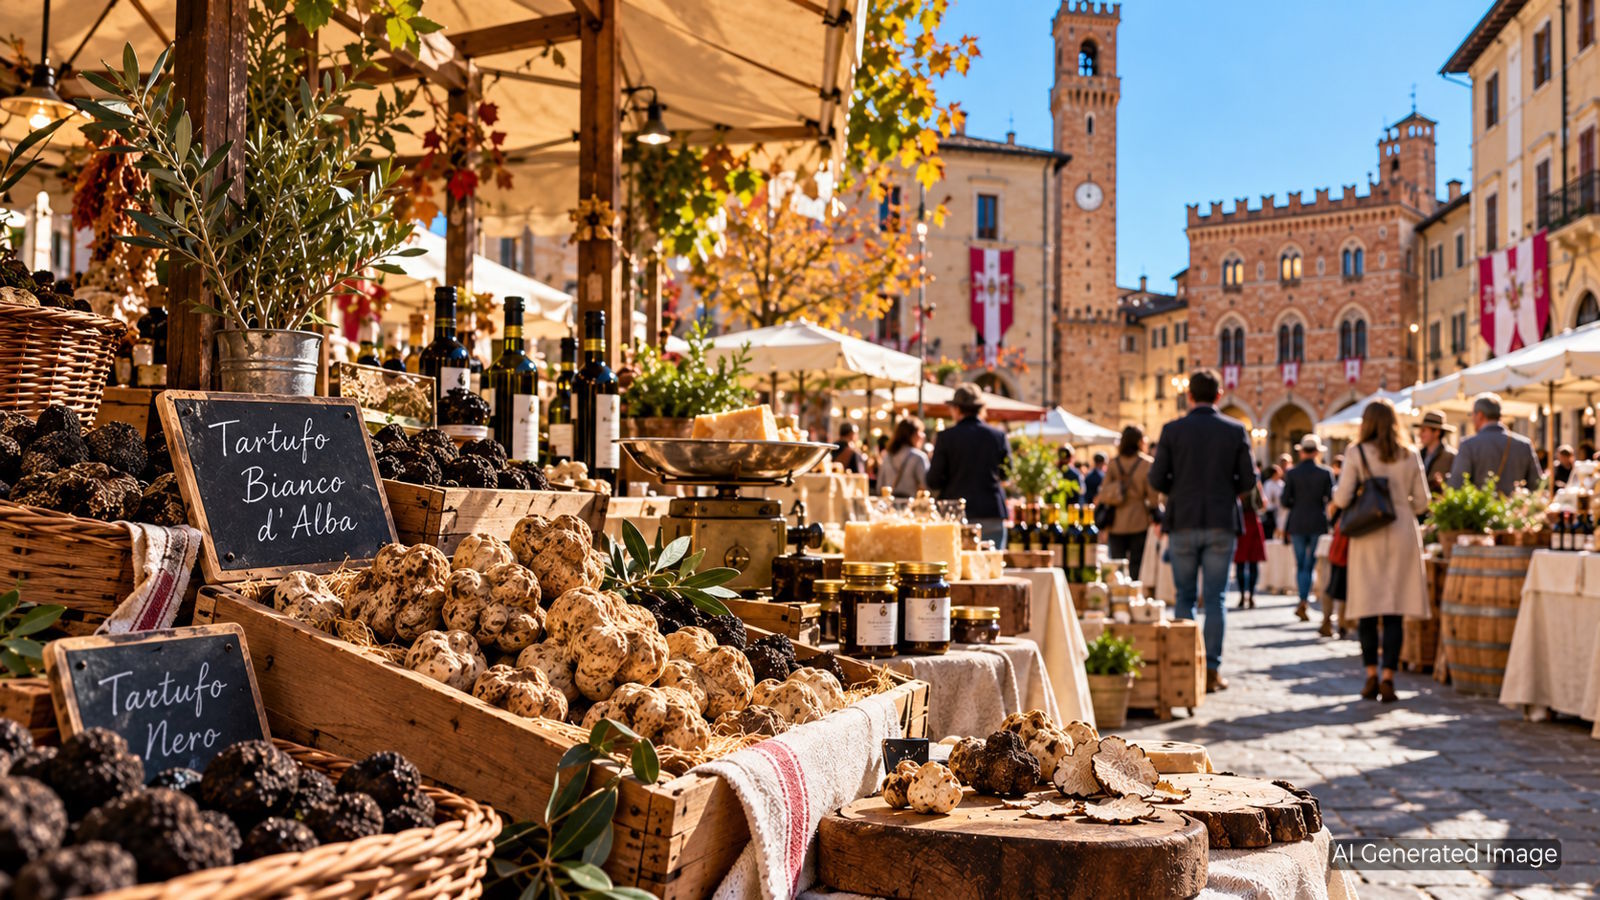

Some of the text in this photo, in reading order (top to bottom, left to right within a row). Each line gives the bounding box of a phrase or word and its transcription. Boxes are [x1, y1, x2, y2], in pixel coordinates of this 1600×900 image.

[207, 417, 330, 465] Tartufo
[240, 465, 345, 504] Bianco
[97, 661, 228, 718] Tartufo
[144, 719, 222, 761] Nero
